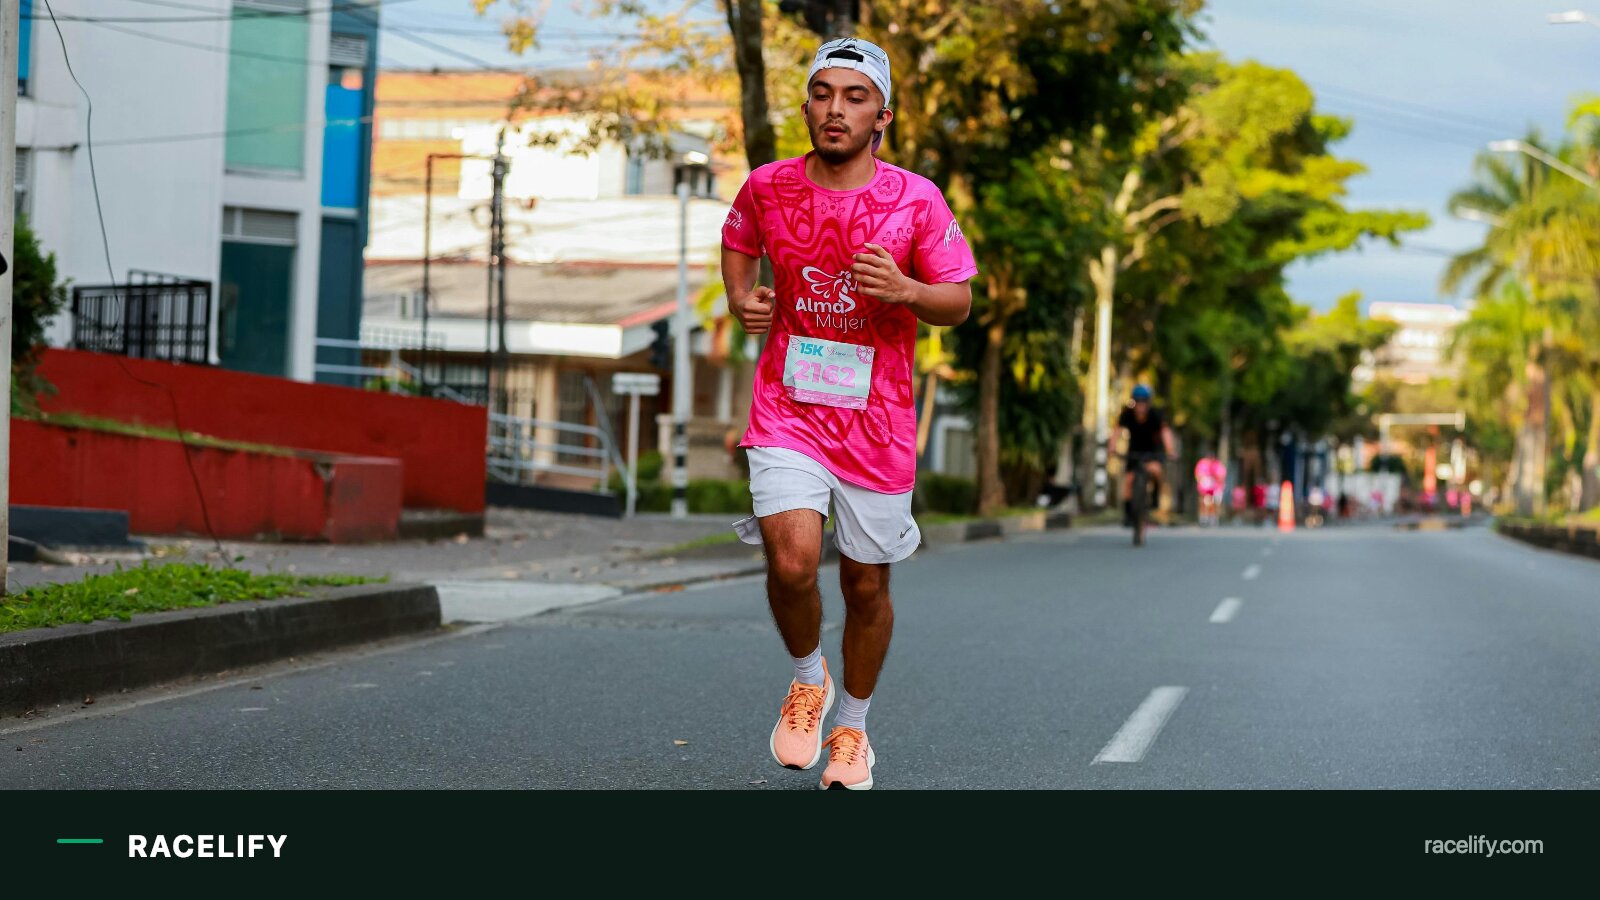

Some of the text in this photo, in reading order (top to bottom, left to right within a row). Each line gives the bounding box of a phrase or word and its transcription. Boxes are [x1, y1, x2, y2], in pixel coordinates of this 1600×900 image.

[795, 297, 845, 314] Alma
[816, 313, 867, 334] Mujer
[800, 342, 824, 357] 15K
[794, 359, 856, 389] 2162
